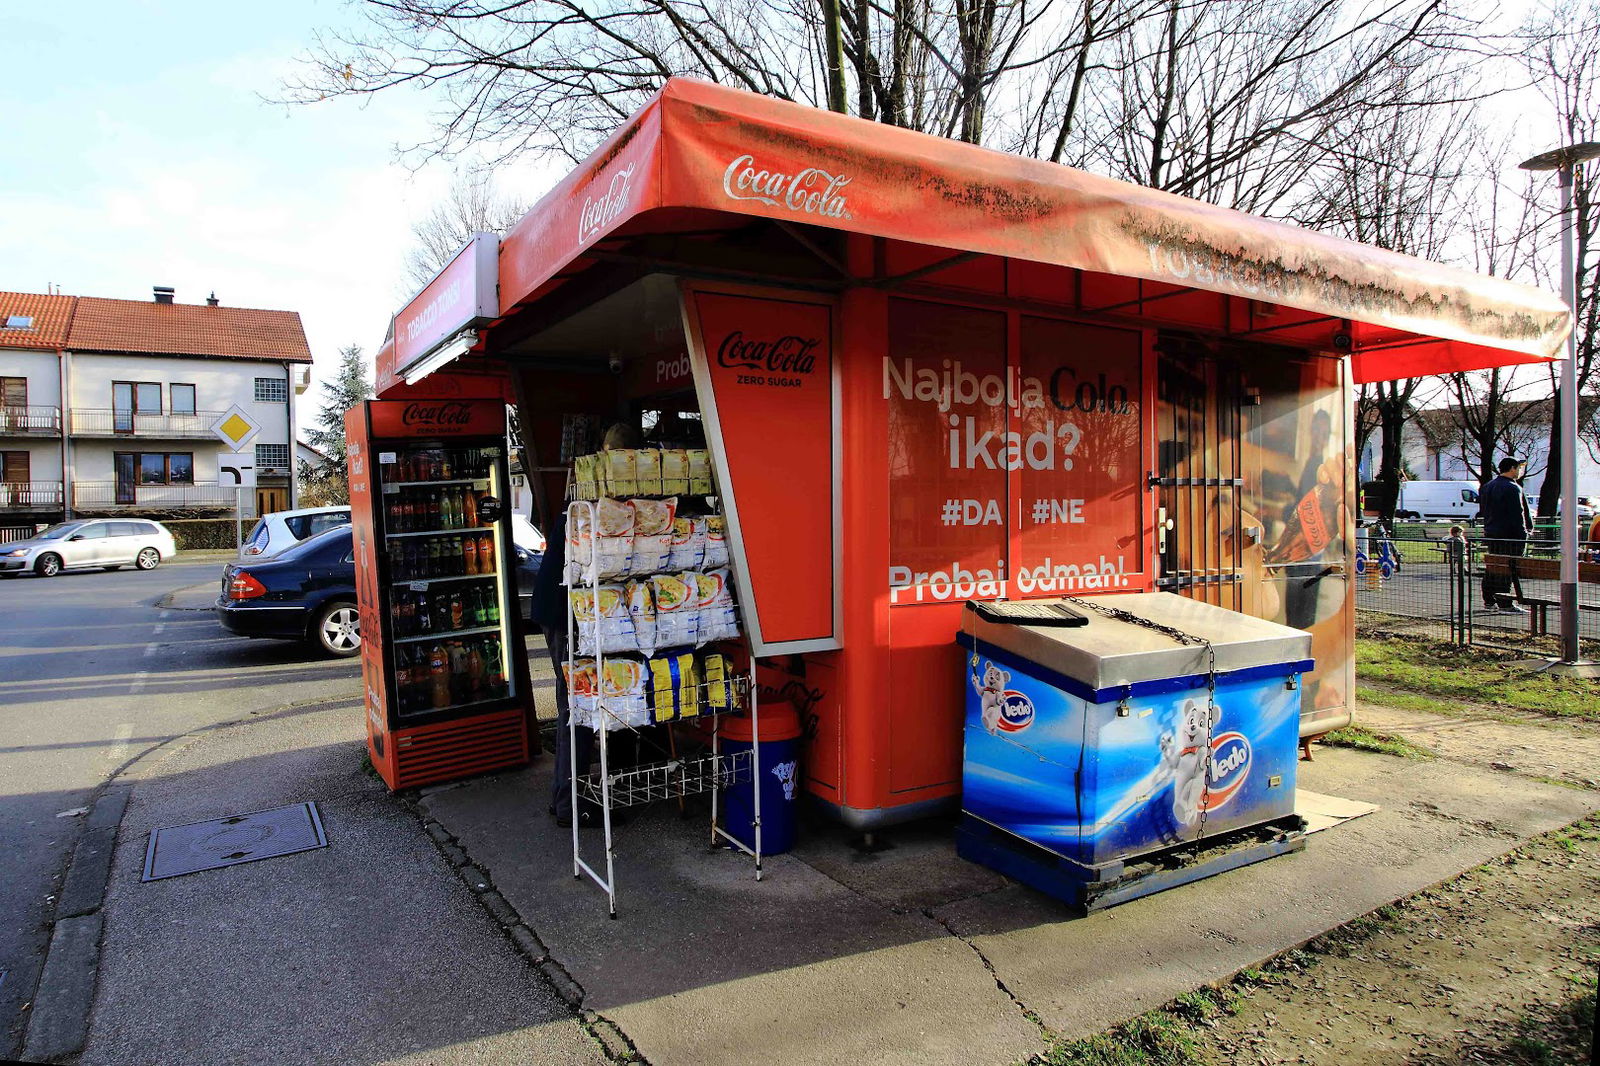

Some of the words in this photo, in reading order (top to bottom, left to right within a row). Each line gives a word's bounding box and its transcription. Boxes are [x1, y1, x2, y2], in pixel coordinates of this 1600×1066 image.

[577, 160, 635, 246] Coca-Cola
[723, 154, 853, 220] Coca-Cola
[656, 352, 693, 384] Prob
[717, 331, 820, 375] Coca-Cola
[736, 375, 764, 386] ZERO
[767, 376, 802, 388] SUGAR
[882, 356, 1045, 418] Najbolja
[402, 402, 473, 426] Coca-Cola
[949, 414, 1081, 472] ikad?
[941, 499, 1003, 526] #DA
[1032, 499, 1085, 524] #NE
[889, 560, 1007, 604] Probaj
[1017, 555, 1129, 592] odmah!
[1004, 701, 1032, 719] ledo
[1211, 743, 1248, 783] ledo
